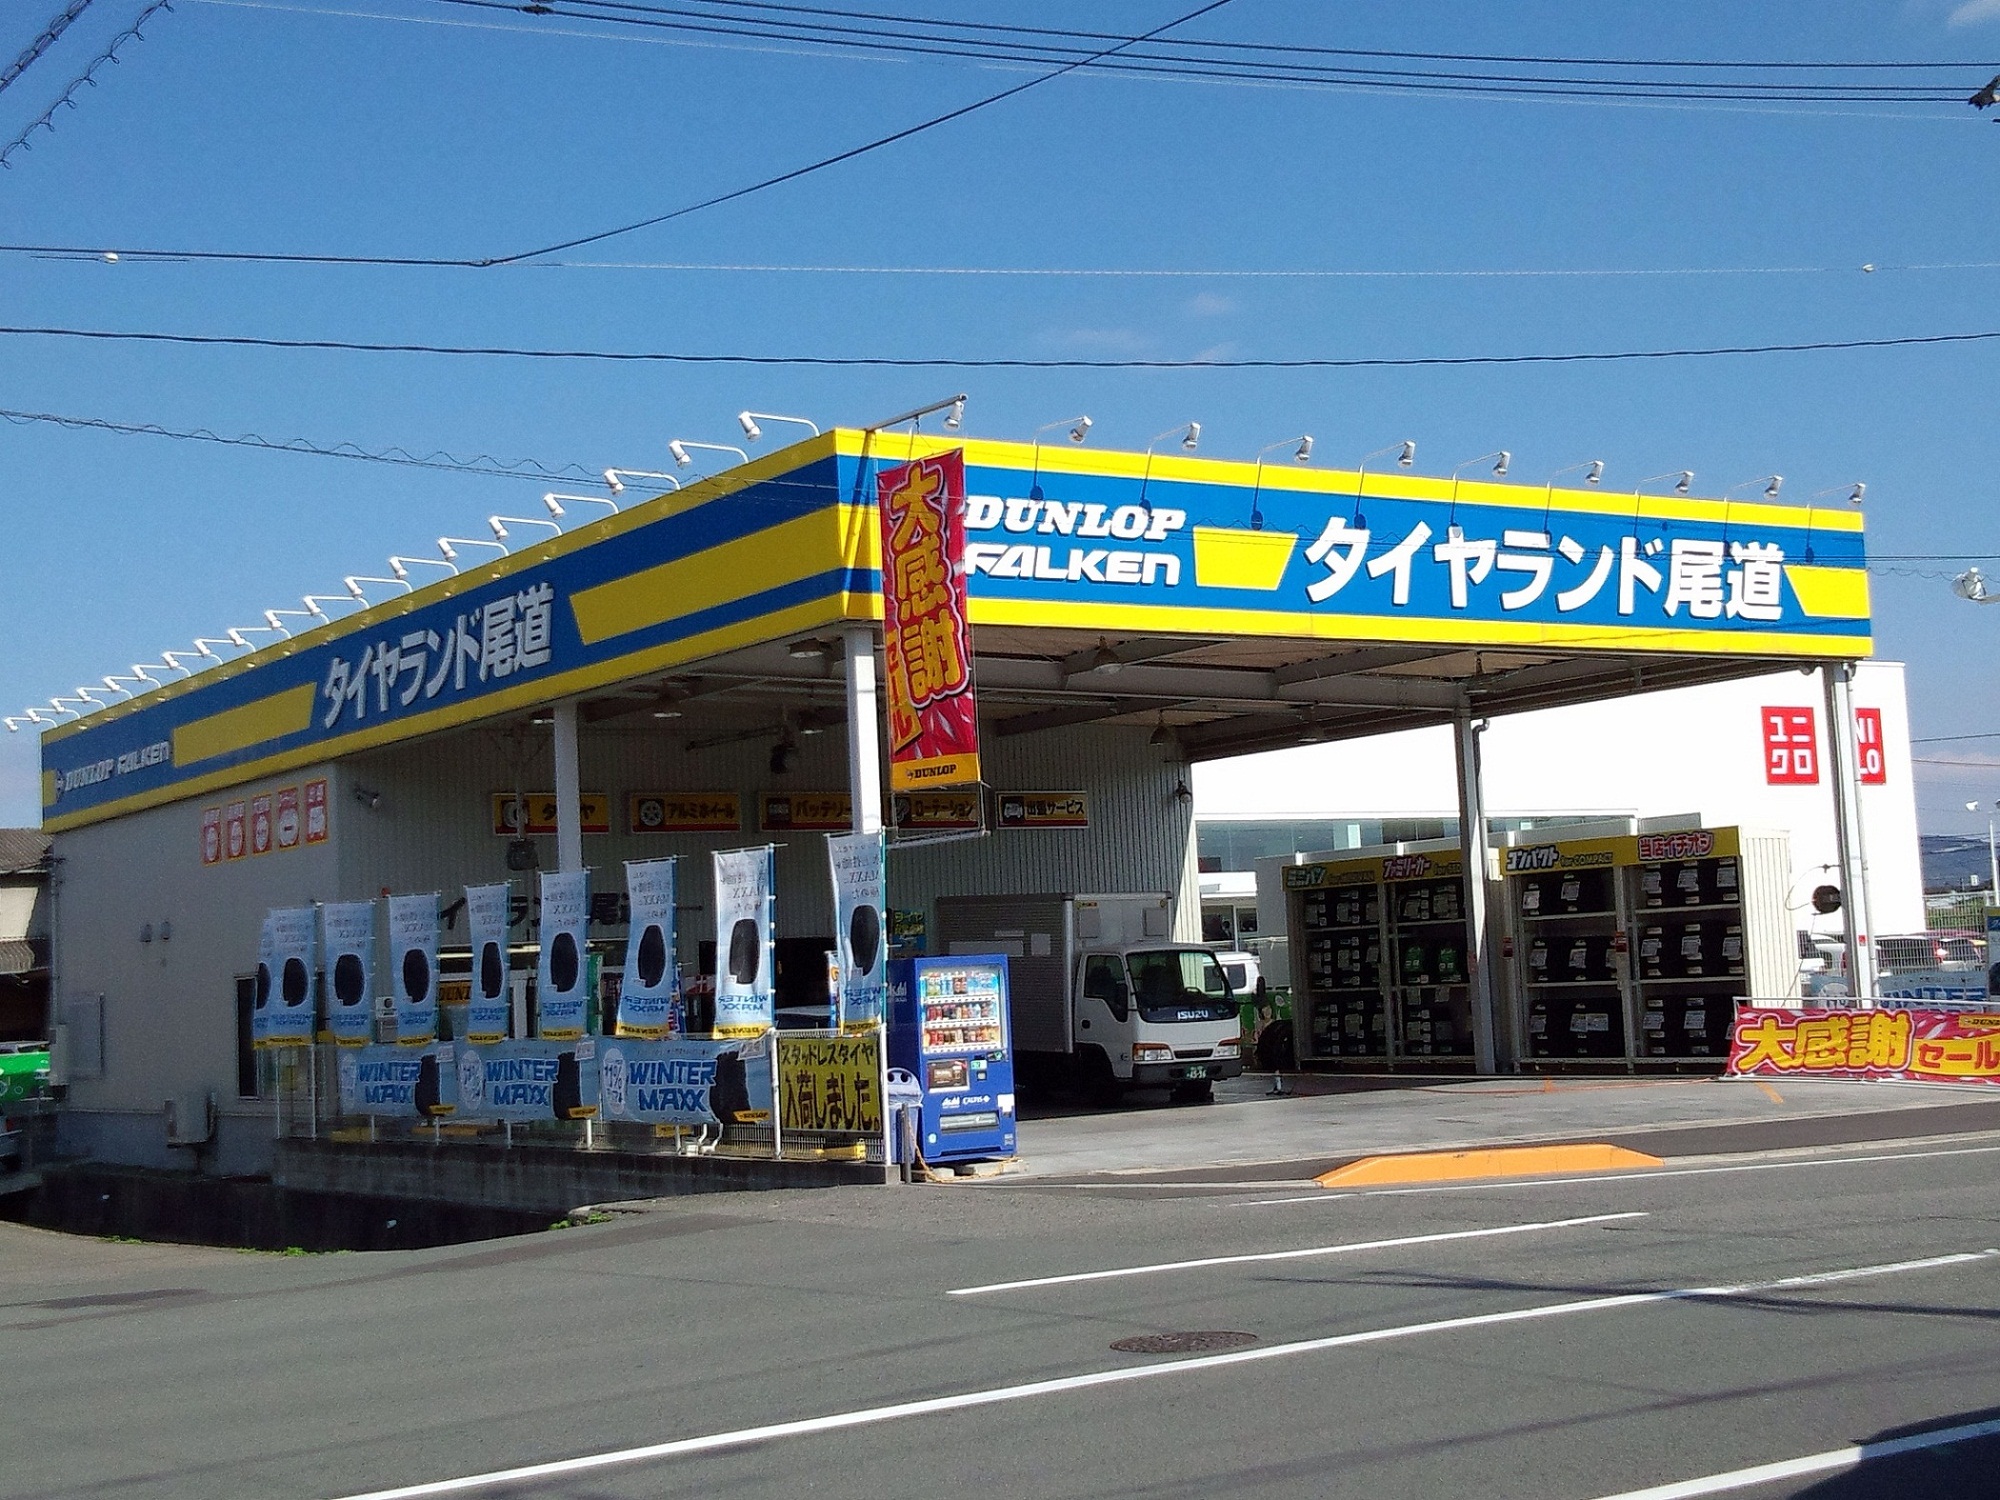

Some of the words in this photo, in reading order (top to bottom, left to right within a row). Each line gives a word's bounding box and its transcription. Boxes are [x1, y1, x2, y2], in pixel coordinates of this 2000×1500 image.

[964, 495, 1186, 540] DUNLOP
[964, 543, 1180, 586] FALKEN
[1304, 516, 1785, 620] タイヤランド尾道
[890, 462, 961, 698] 大感謝
[323, 582, 554, 729] タイヤランド尾道
[1769, 716, 1811, 743] ユニ
[914, 763, 957, 779] DUNLOP
[1771, 749, 1813, 775] クロ
[65, 758, 115, 792] DUNLOP
[542, 803, 597, 821] タヤ
[667, 801, 736, 820] アルミホイール
[914, 799, 975, 818] ローテーション
[1506, 846, 1559, 871] コンパクト
[1177, 1010, 1208, 1020] ISUZU
[1737, 1010, 1911, 1070] 大感謝
[1918, 1040, 2000, 1070] セール
[781, 1043, 874, 1065] スタッドレスタイヤ
[359, 1061, 421, 1082] WINTER
[487, 1060, 558, 1083] WINTER
[630, 1060, 717, 1085] WINTER
[365, 1084, 414, 1104] MAXX
[494, 1084, 551, 1106] MAXX
[639, 1088, 707, 1112] MAXX
[783, 1069, 880, 1131] 入荷しました。
